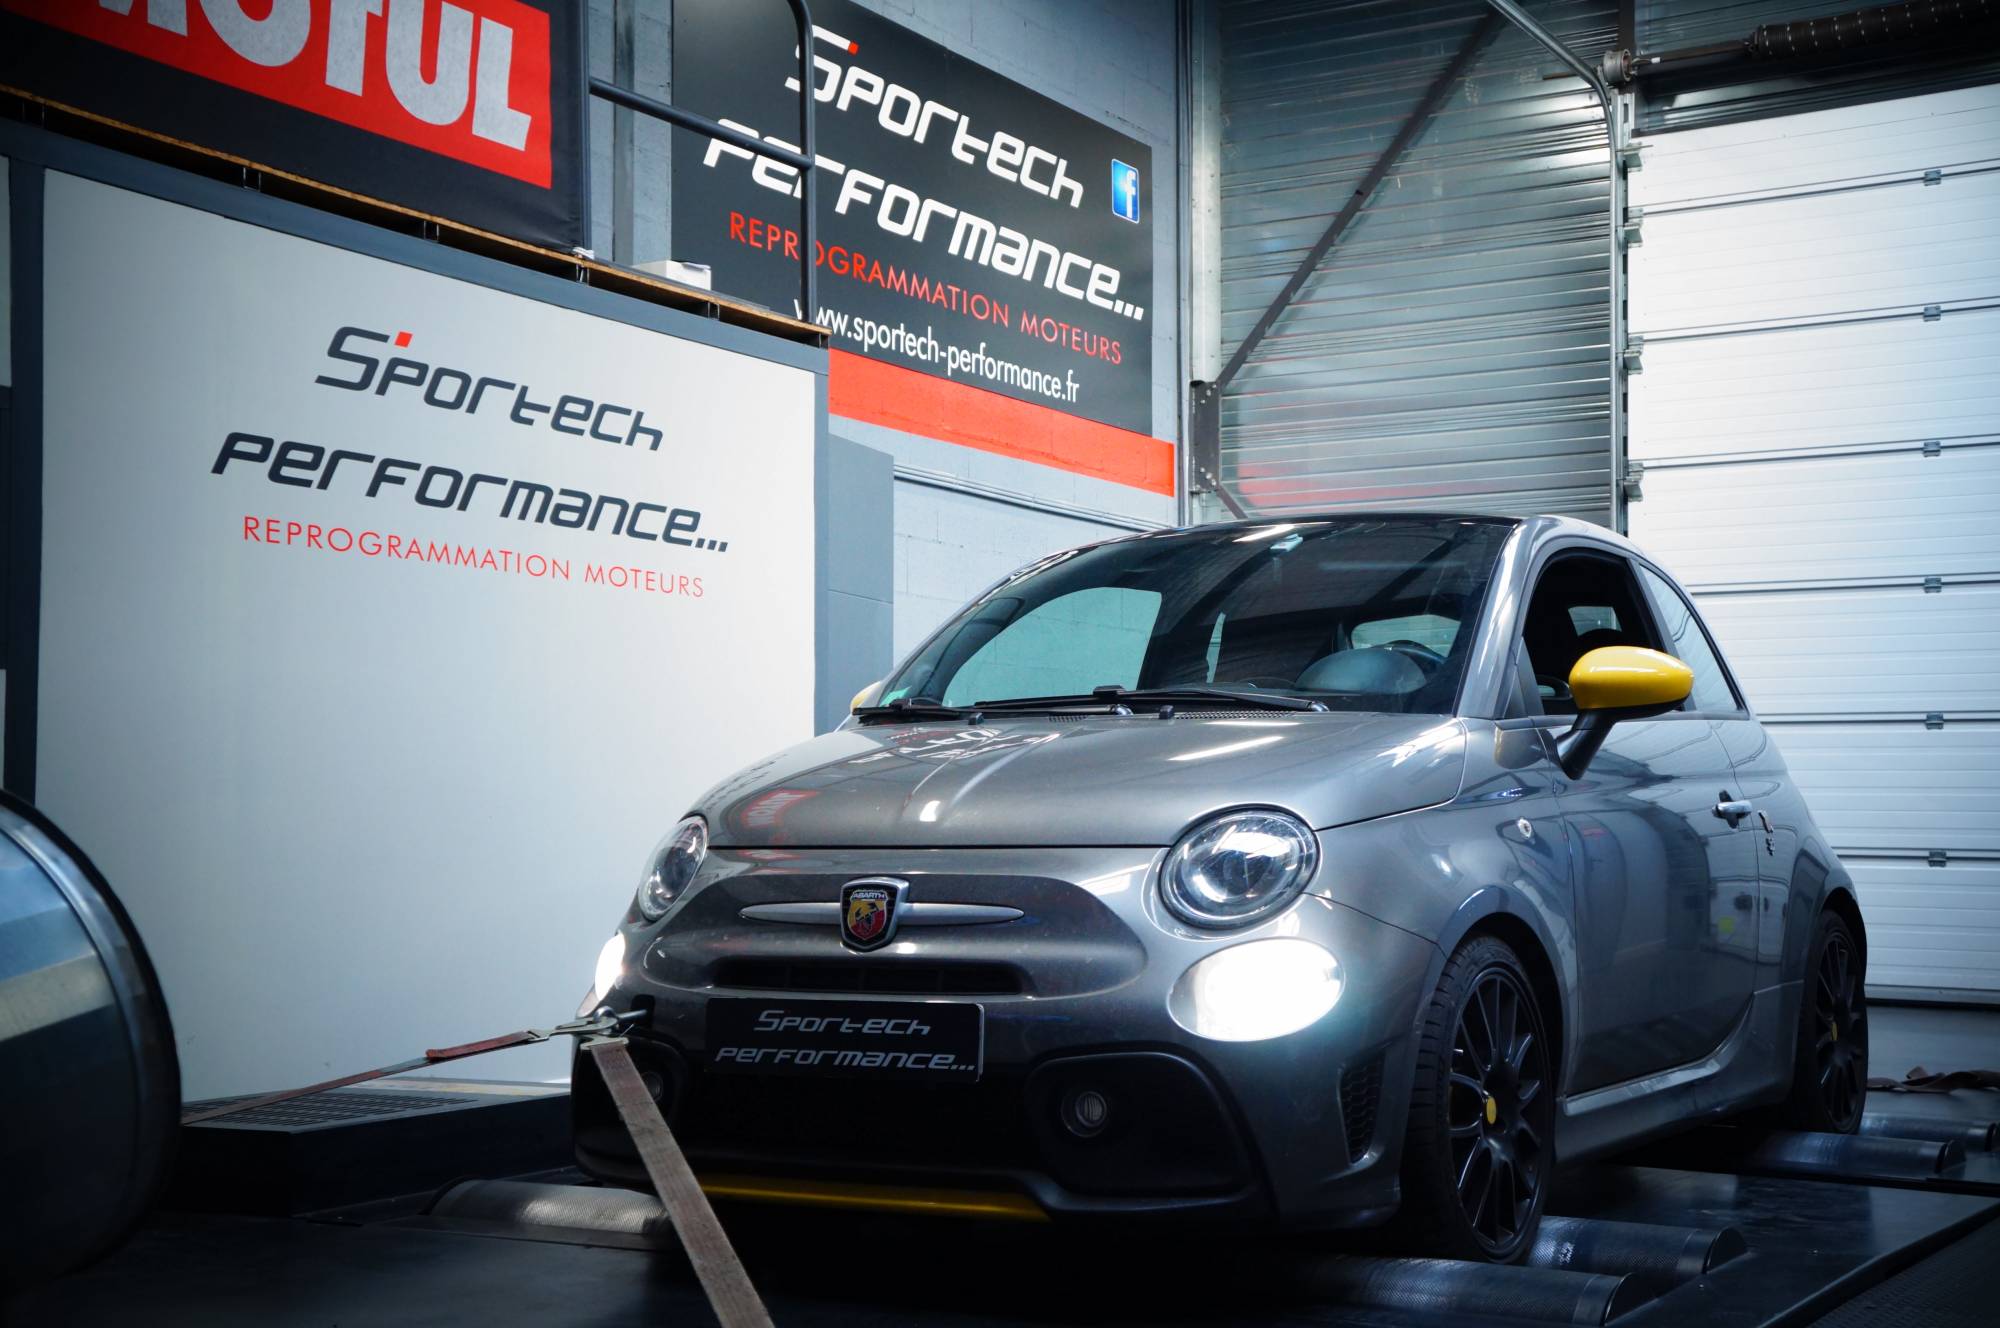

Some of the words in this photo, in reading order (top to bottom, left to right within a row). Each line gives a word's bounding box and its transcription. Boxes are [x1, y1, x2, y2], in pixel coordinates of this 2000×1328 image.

[97, 0, 532, 151] OTUL
[1021, 309, 1122, 365] MOTEURS
[243, 516, 570, 581] REPROGRAMMATION
[585, 564, 704, 598] MOTEURS
